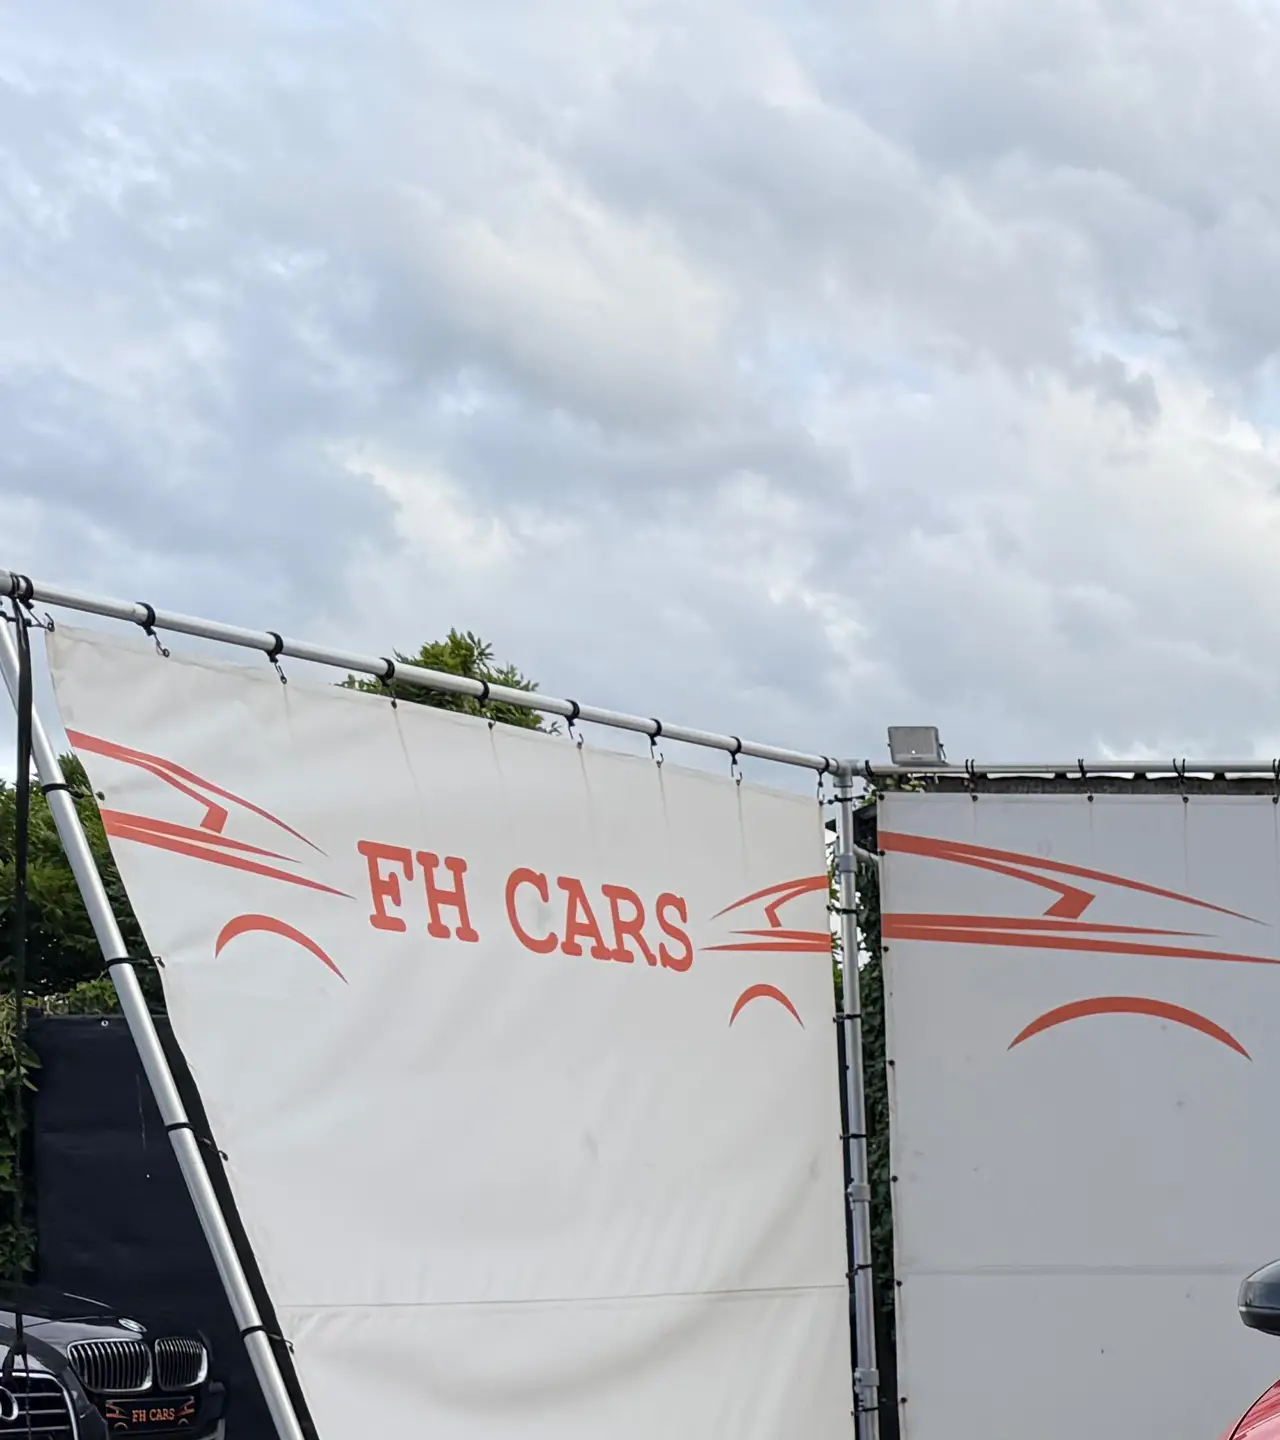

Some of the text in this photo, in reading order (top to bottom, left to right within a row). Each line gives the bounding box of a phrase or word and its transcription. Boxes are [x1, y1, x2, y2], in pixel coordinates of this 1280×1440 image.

[357, 839, 694, 972] FH CARS
[132, 1408, 175, 1422] FH CARS
